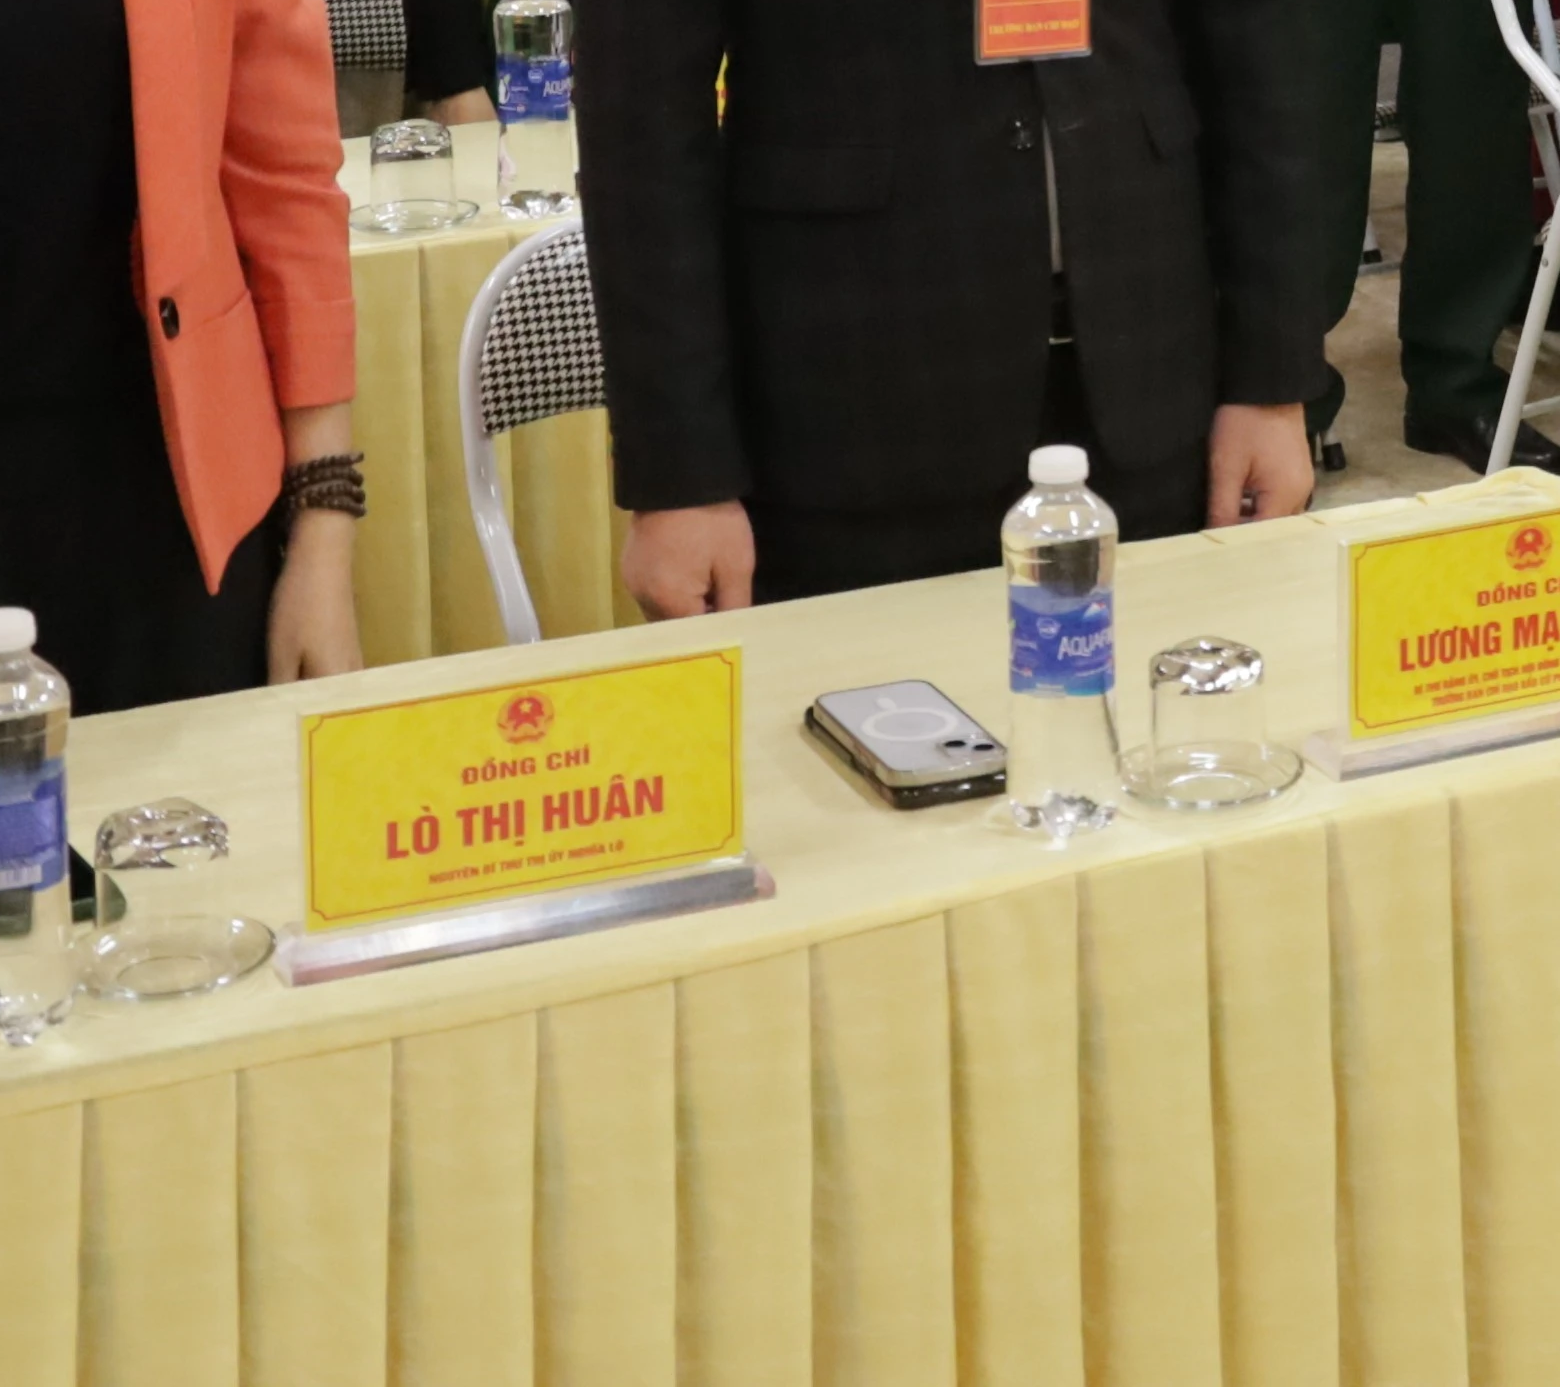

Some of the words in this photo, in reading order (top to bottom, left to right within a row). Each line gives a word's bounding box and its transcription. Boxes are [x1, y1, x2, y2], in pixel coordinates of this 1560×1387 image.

[1477, 581, 1537, 607] ĐỒNG
[1399, 621, 1502, 672] LƯƠNG
[461, 756, 536, 785] ĐỒNG
[546, 743, 591, 771] CHÍ
[386, 804, 439, 861] LÒ
[456, 799, 526, 846] THỊ
[542, 774, 665, 833] HUÂN
